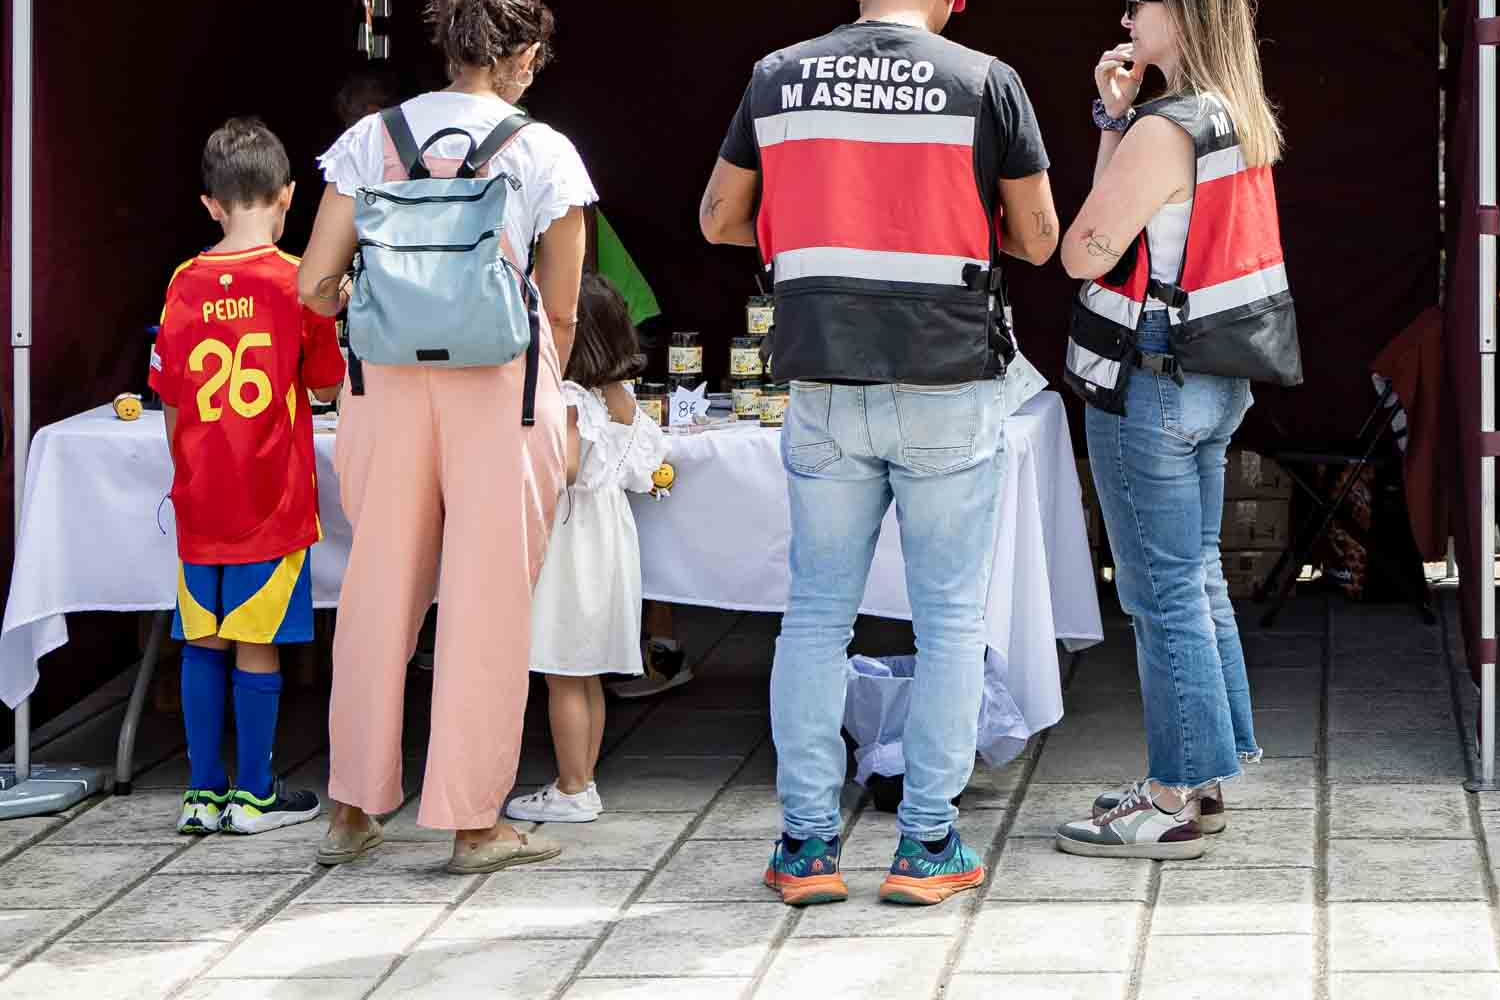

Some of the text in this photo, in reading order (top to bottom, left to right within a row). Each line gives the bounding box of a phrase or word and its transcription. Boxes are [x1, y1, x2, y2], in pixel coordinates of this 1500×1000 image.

[800, 55, 934, 83] TECNICO
[781, 82, 948, 112] M ASENSIO
[203, 296, 254, 323] PEDRI
[188, 332, 273, 422] 26
